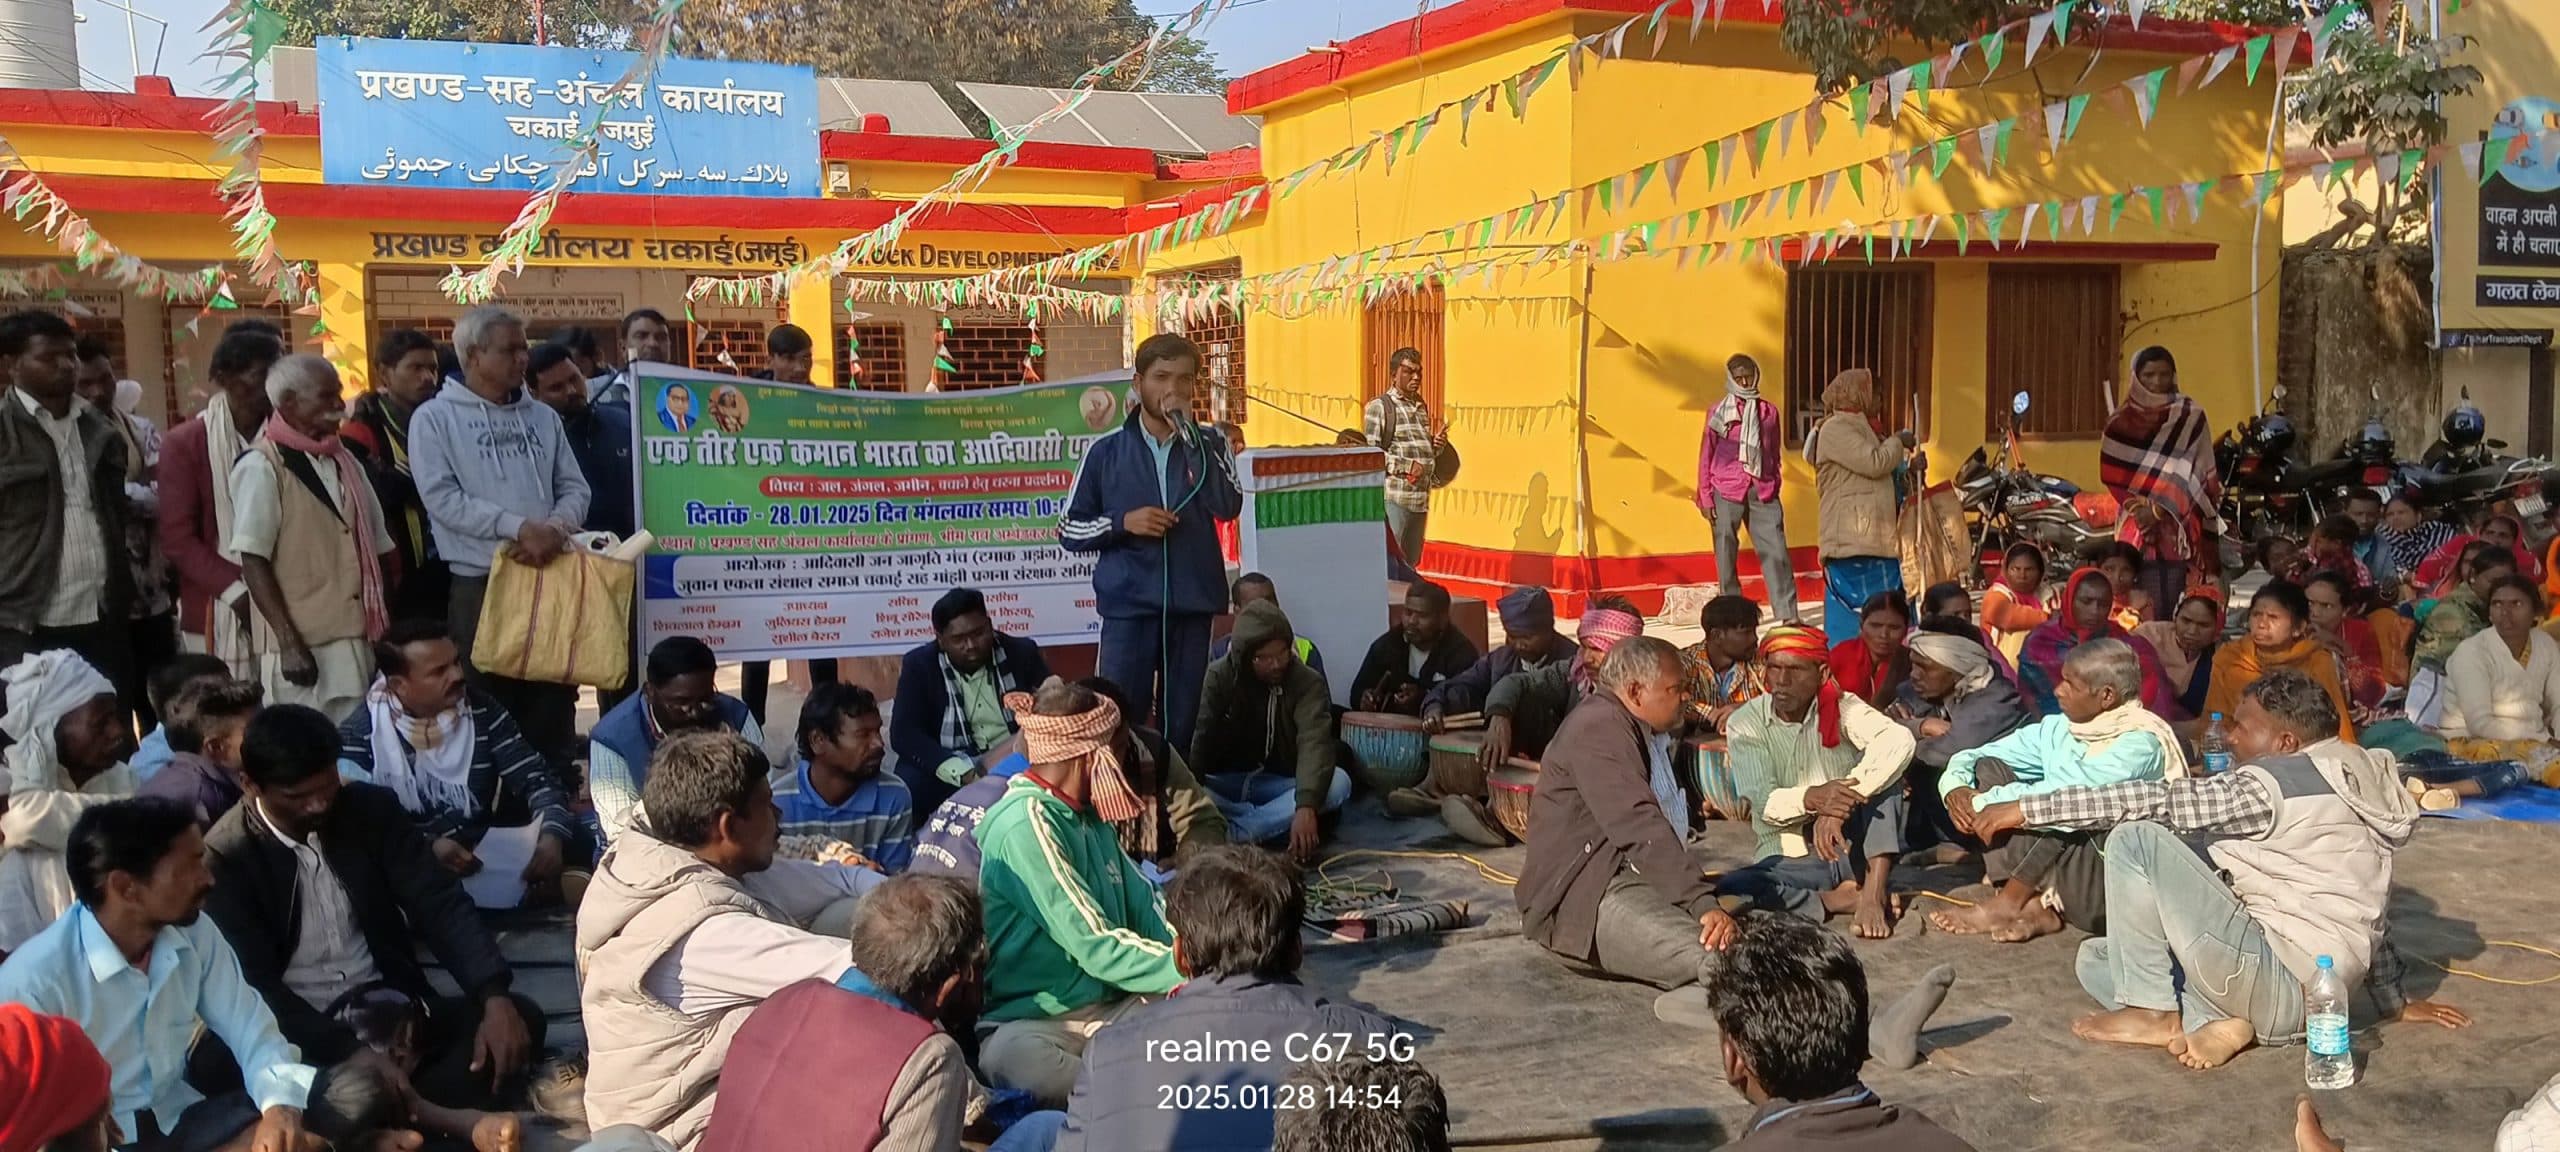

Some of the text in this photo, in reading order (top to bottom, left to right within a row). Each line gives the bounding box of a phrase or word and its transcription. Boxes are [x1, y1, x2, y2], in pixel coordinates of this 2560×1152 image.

[658, 78, 785, 117] कार्यालय
[601, 114, 655, 150] जमुई
[2484, 203, 2558, 228] वाहन अपनी
[370, 232, 468, 258] प्रखण्ड
[475, 228, 634, 259] कर्यालय
[846, 243, 916, 267] OCK
[2495, 228, 2509, 253] में
[2511, 229, 2527, 255] ही
[2485, 282, 2530, 301] गलत
[644, 435, 690, 466] एक
[694, 428, 737, 467] तीर
[741, 438, 784, 467] एक
[787, 439, 858, 469] कमान
[862, 439, 919, 468] भारत
[921, 439, 956, 467] का
[961, 429, 1065, 465] आदिवासी
[768, 478, 804, 494] विषय
[685, 500, 751, 527] दिनांक
[769, 502, 870, 526] 28.01.2025
[874, 500, 909, 524] दिन
[911, 497, 985, 523] मंगलवार
[986, 500, 1031, 519] समय
[723, 554, 787, 572] आयोजक
[801, 554, 866, 570] आदिवासी
